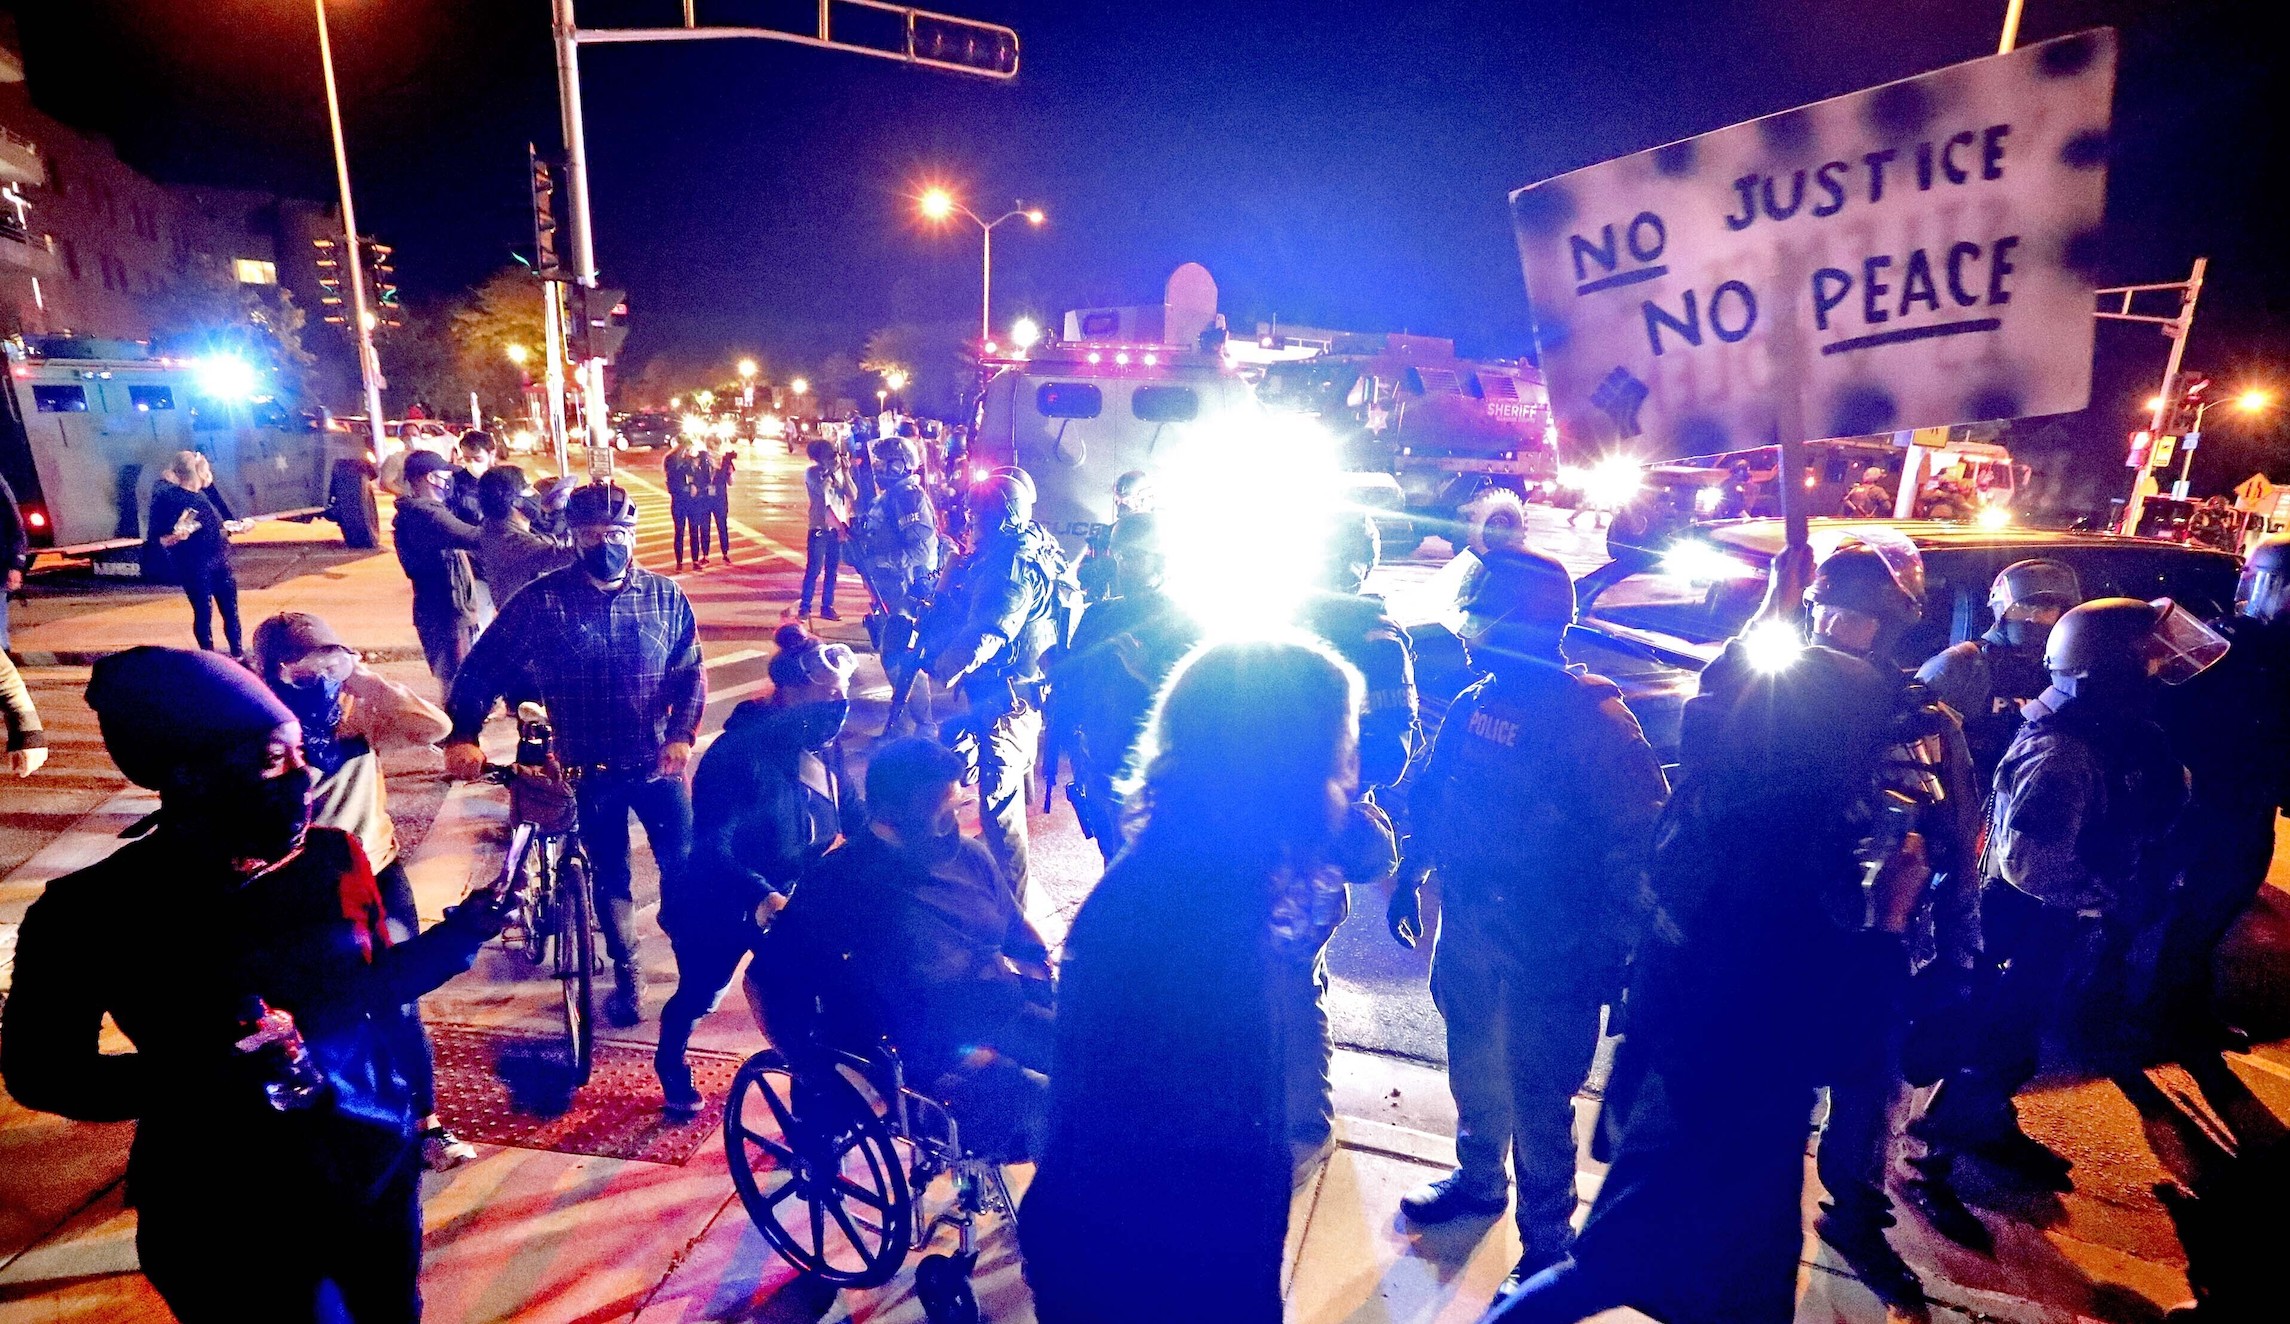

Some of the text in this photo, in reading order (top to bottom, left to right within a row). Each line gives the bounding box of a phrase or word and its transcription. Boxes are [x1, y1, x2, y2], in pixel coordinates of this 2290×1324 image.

[1568, 124, 2012, 279] NO JUSTICE
[1644, 235, 2020, 356] NO PEACE
[1487, 402, 1537, 418] SHERIFF
[1469, 709, 1520, 748] POLICE
